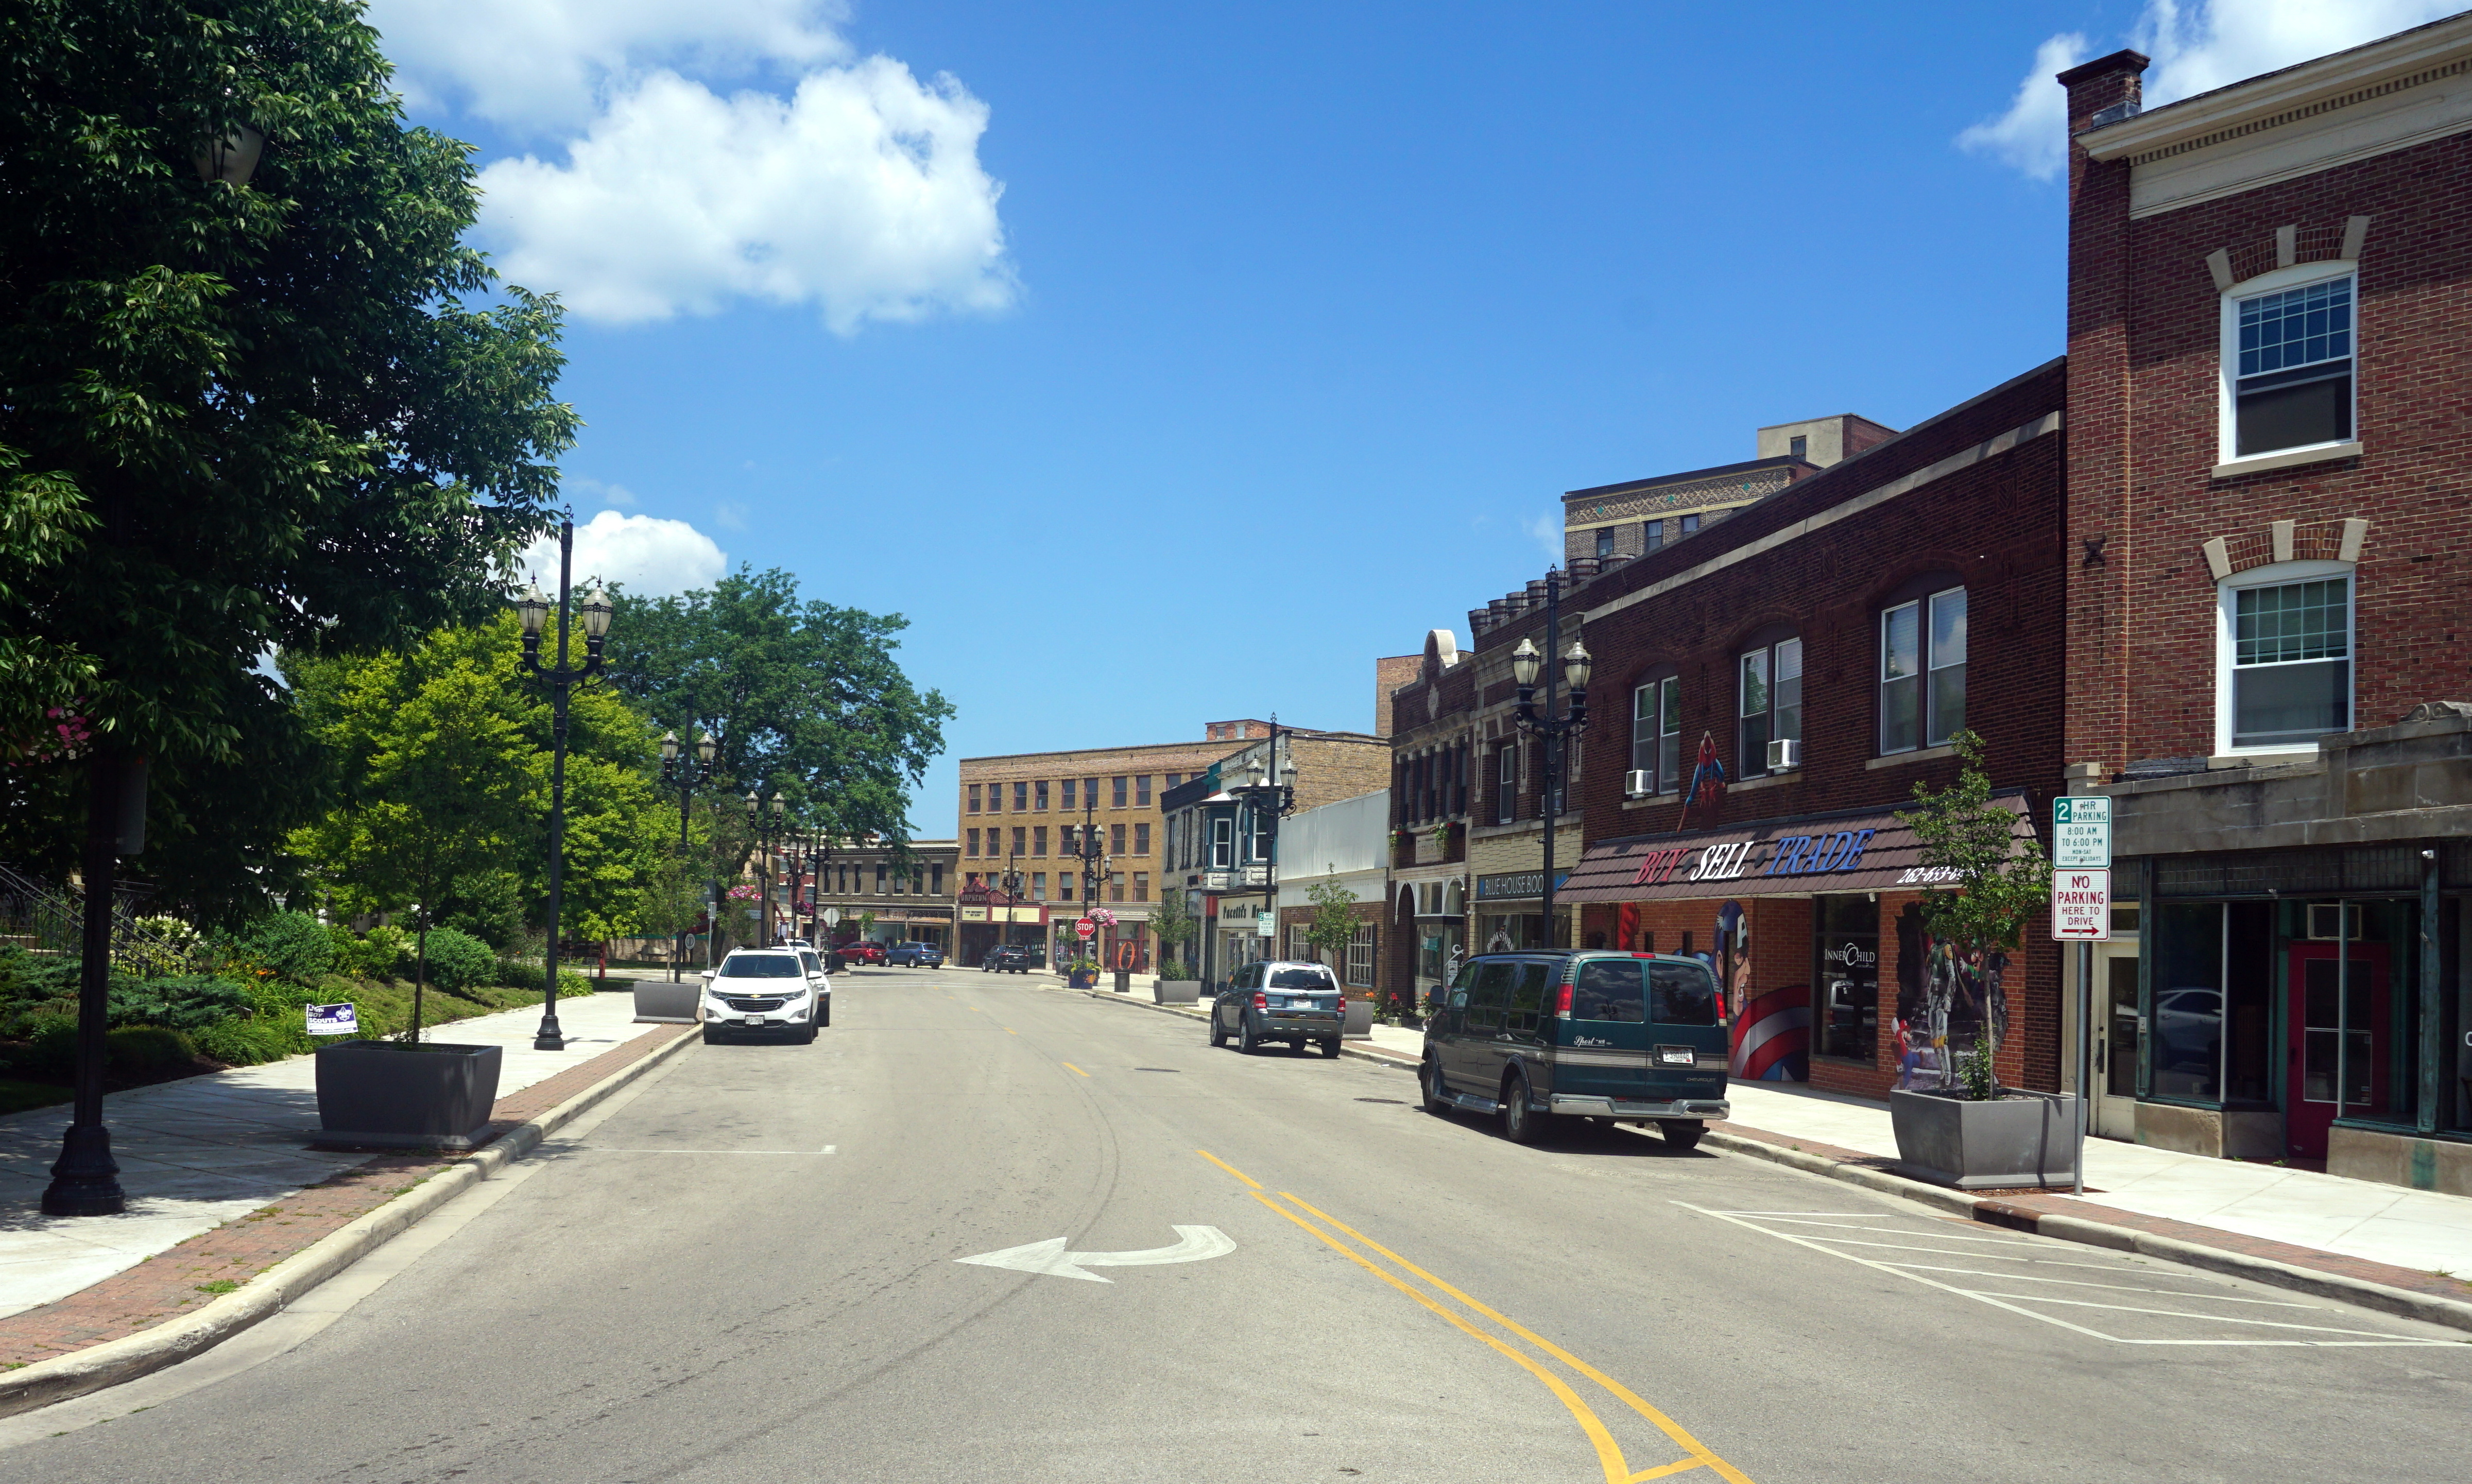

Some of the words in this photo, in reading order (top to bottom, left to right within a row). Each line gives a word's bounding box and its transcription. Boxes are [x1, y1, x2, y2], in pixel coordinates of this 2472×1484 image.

[2058, 802, 2069, 820] 2
[2083, 801, 2096, 809] HR
[2073, 812, 2106, 821] PARKING
[2062, 838, 2070, 847] TO
[2073, 838, 2089, 847] 6:00
[2093, 838, 2103, 846] PM
[1632, 848, 1690, 884] BUY
[1690, 841, 1754, 881] SELL
[1764, 829, 1876, 875] TRADE
[1485, 878, 1500, 895] BLUE
[1501, 876, 1526, 894] HOUSE
[1526, 874, 1544, 893] BOO
[2072, 875, 2089, 889] NO
[2057, 891, 2104, 904] PARKING
[2062, 906, 2085, 914] HERE
[2089, 906, 2100, 914] TO
[2068, 917, 2093, 925] DRIVE
[1574, 1035, 1595, 1047] Sport
